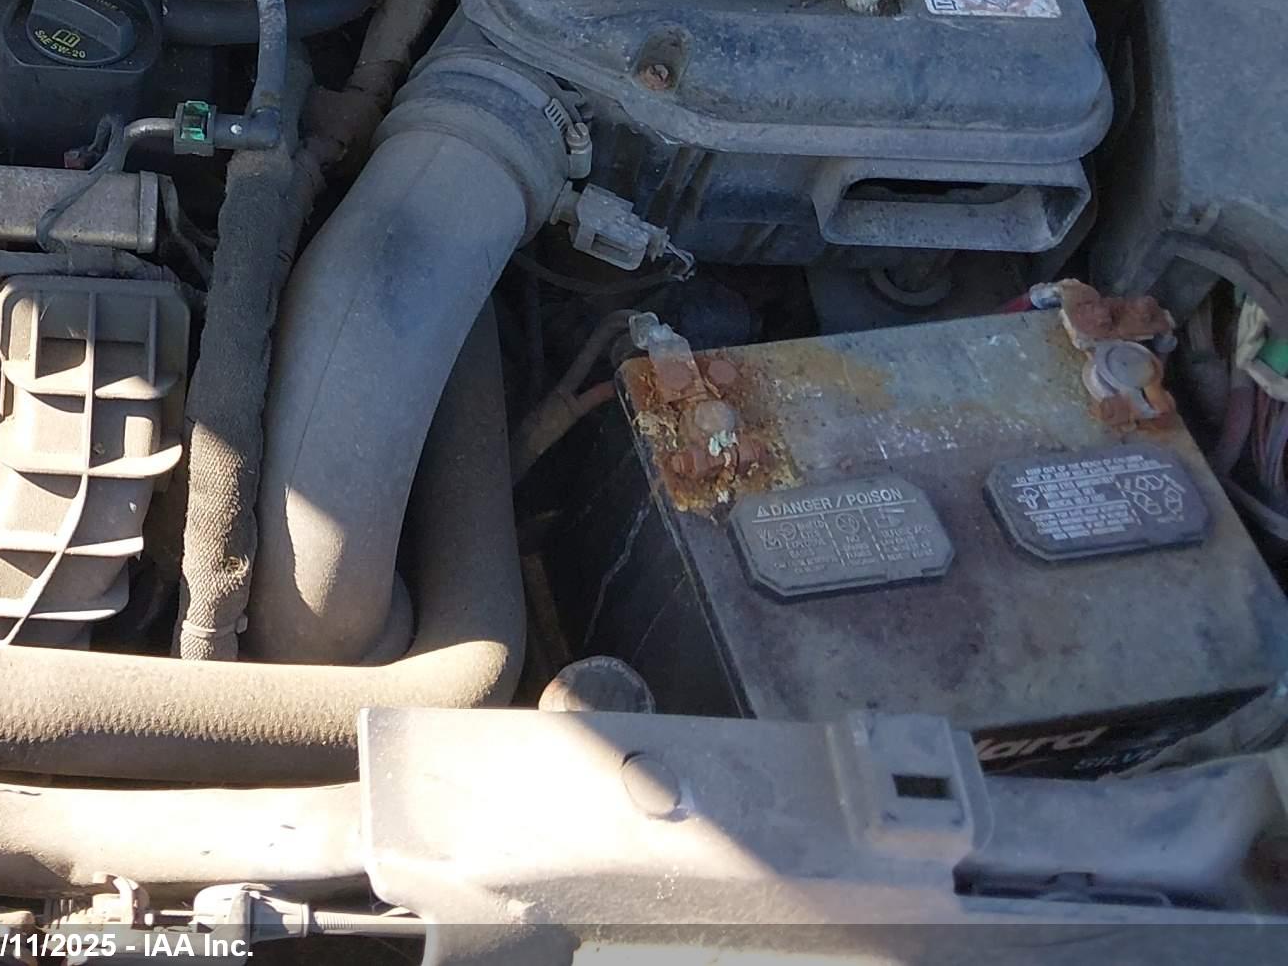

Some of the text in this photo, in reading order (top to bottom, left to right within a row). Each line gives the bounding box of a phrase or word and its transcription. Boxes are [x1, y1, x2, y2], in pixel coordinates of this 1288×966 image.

[34, 29, 86, 59] SAE 5W-20
[770, 497, 833, 517] DANGER
[848, 487, 904, 507] POISON
